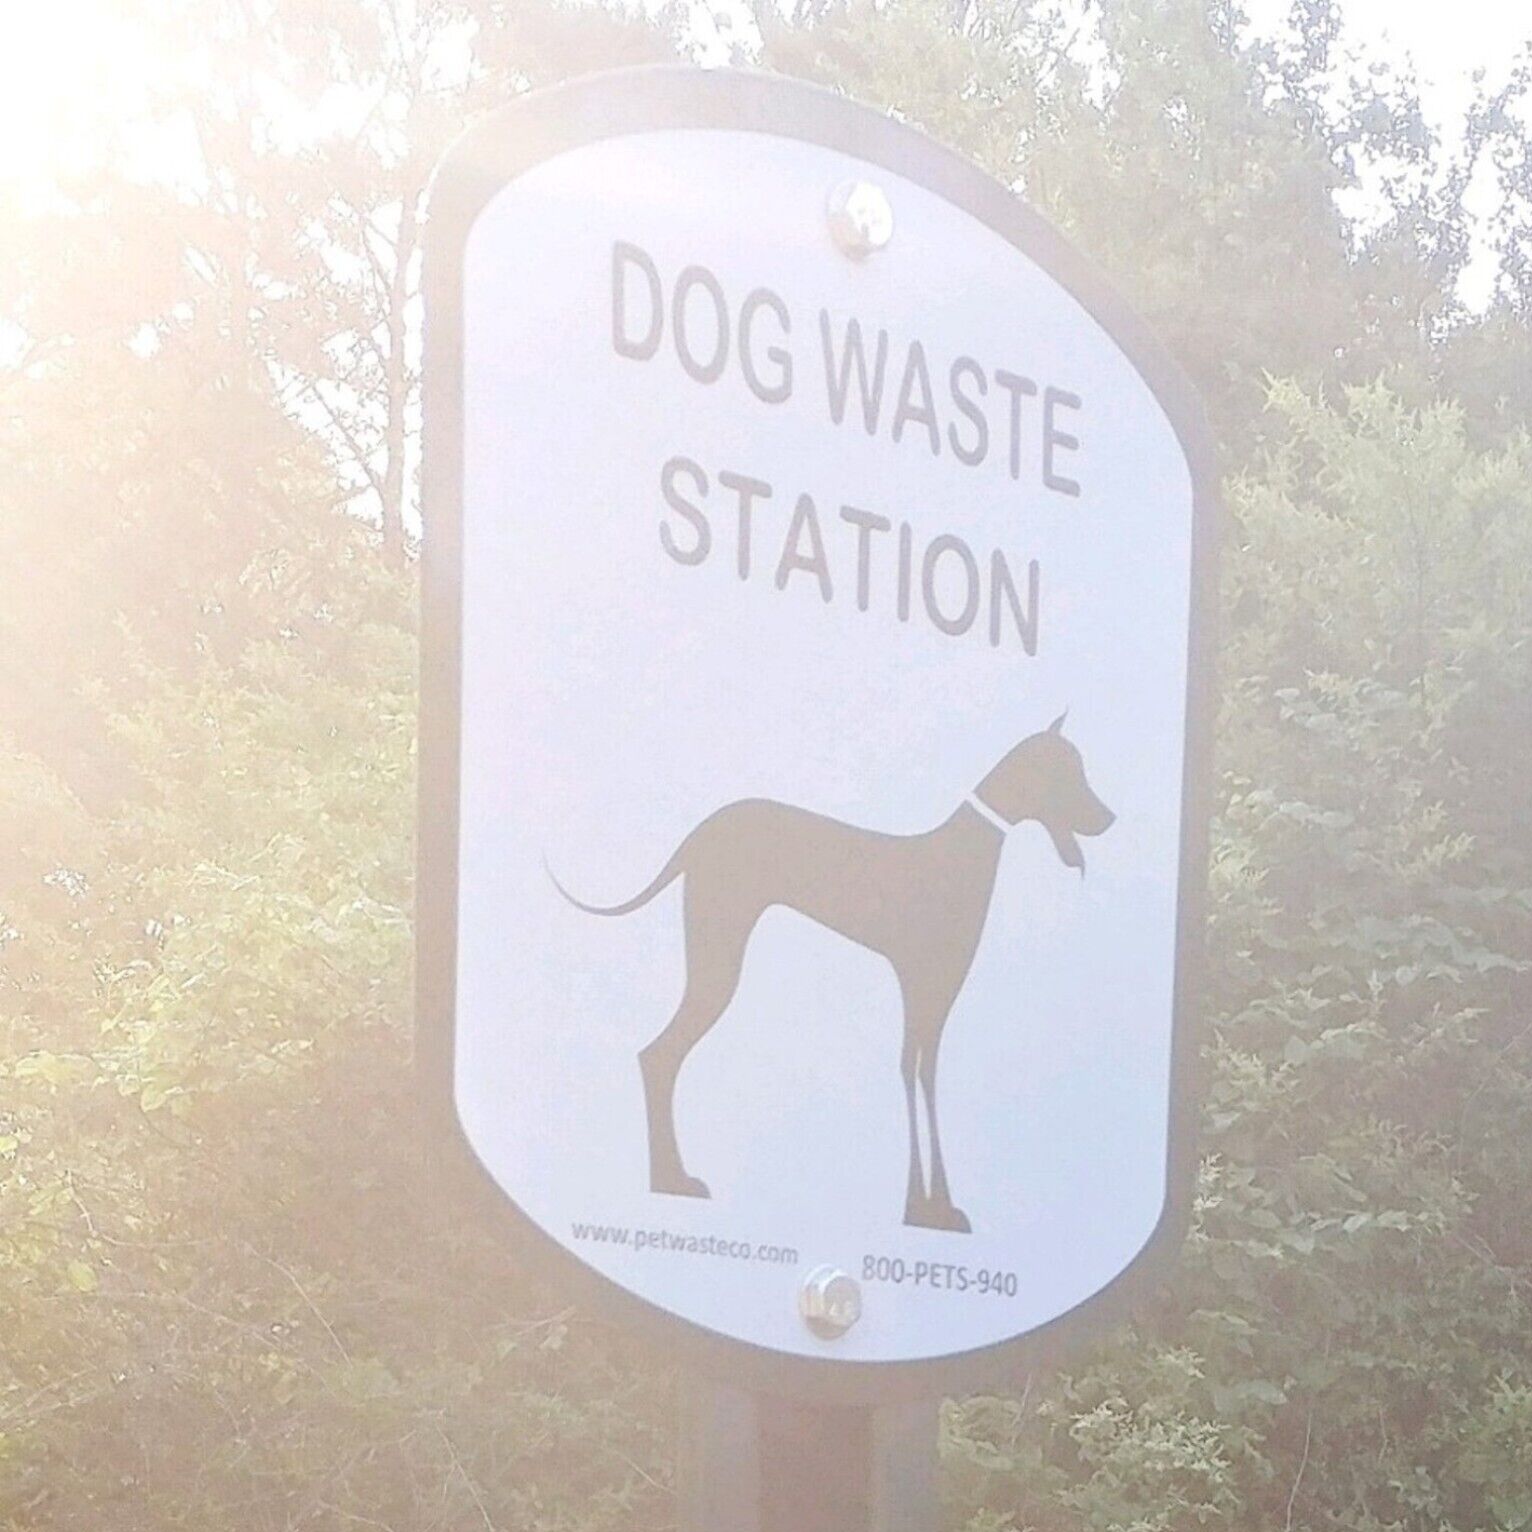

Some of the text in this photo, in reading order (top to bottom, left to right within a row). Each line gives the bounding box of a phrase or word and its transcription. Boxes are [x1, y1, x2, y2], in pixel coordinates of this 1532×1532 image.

[611, 240, 1082, 498] DOG WASTE
[660, 456, 1040, 657] STATION
[571, 1222, 798, 1265] www.petwasteco.com
[862, 1254, 1018, 1297] 800-PETS-940
